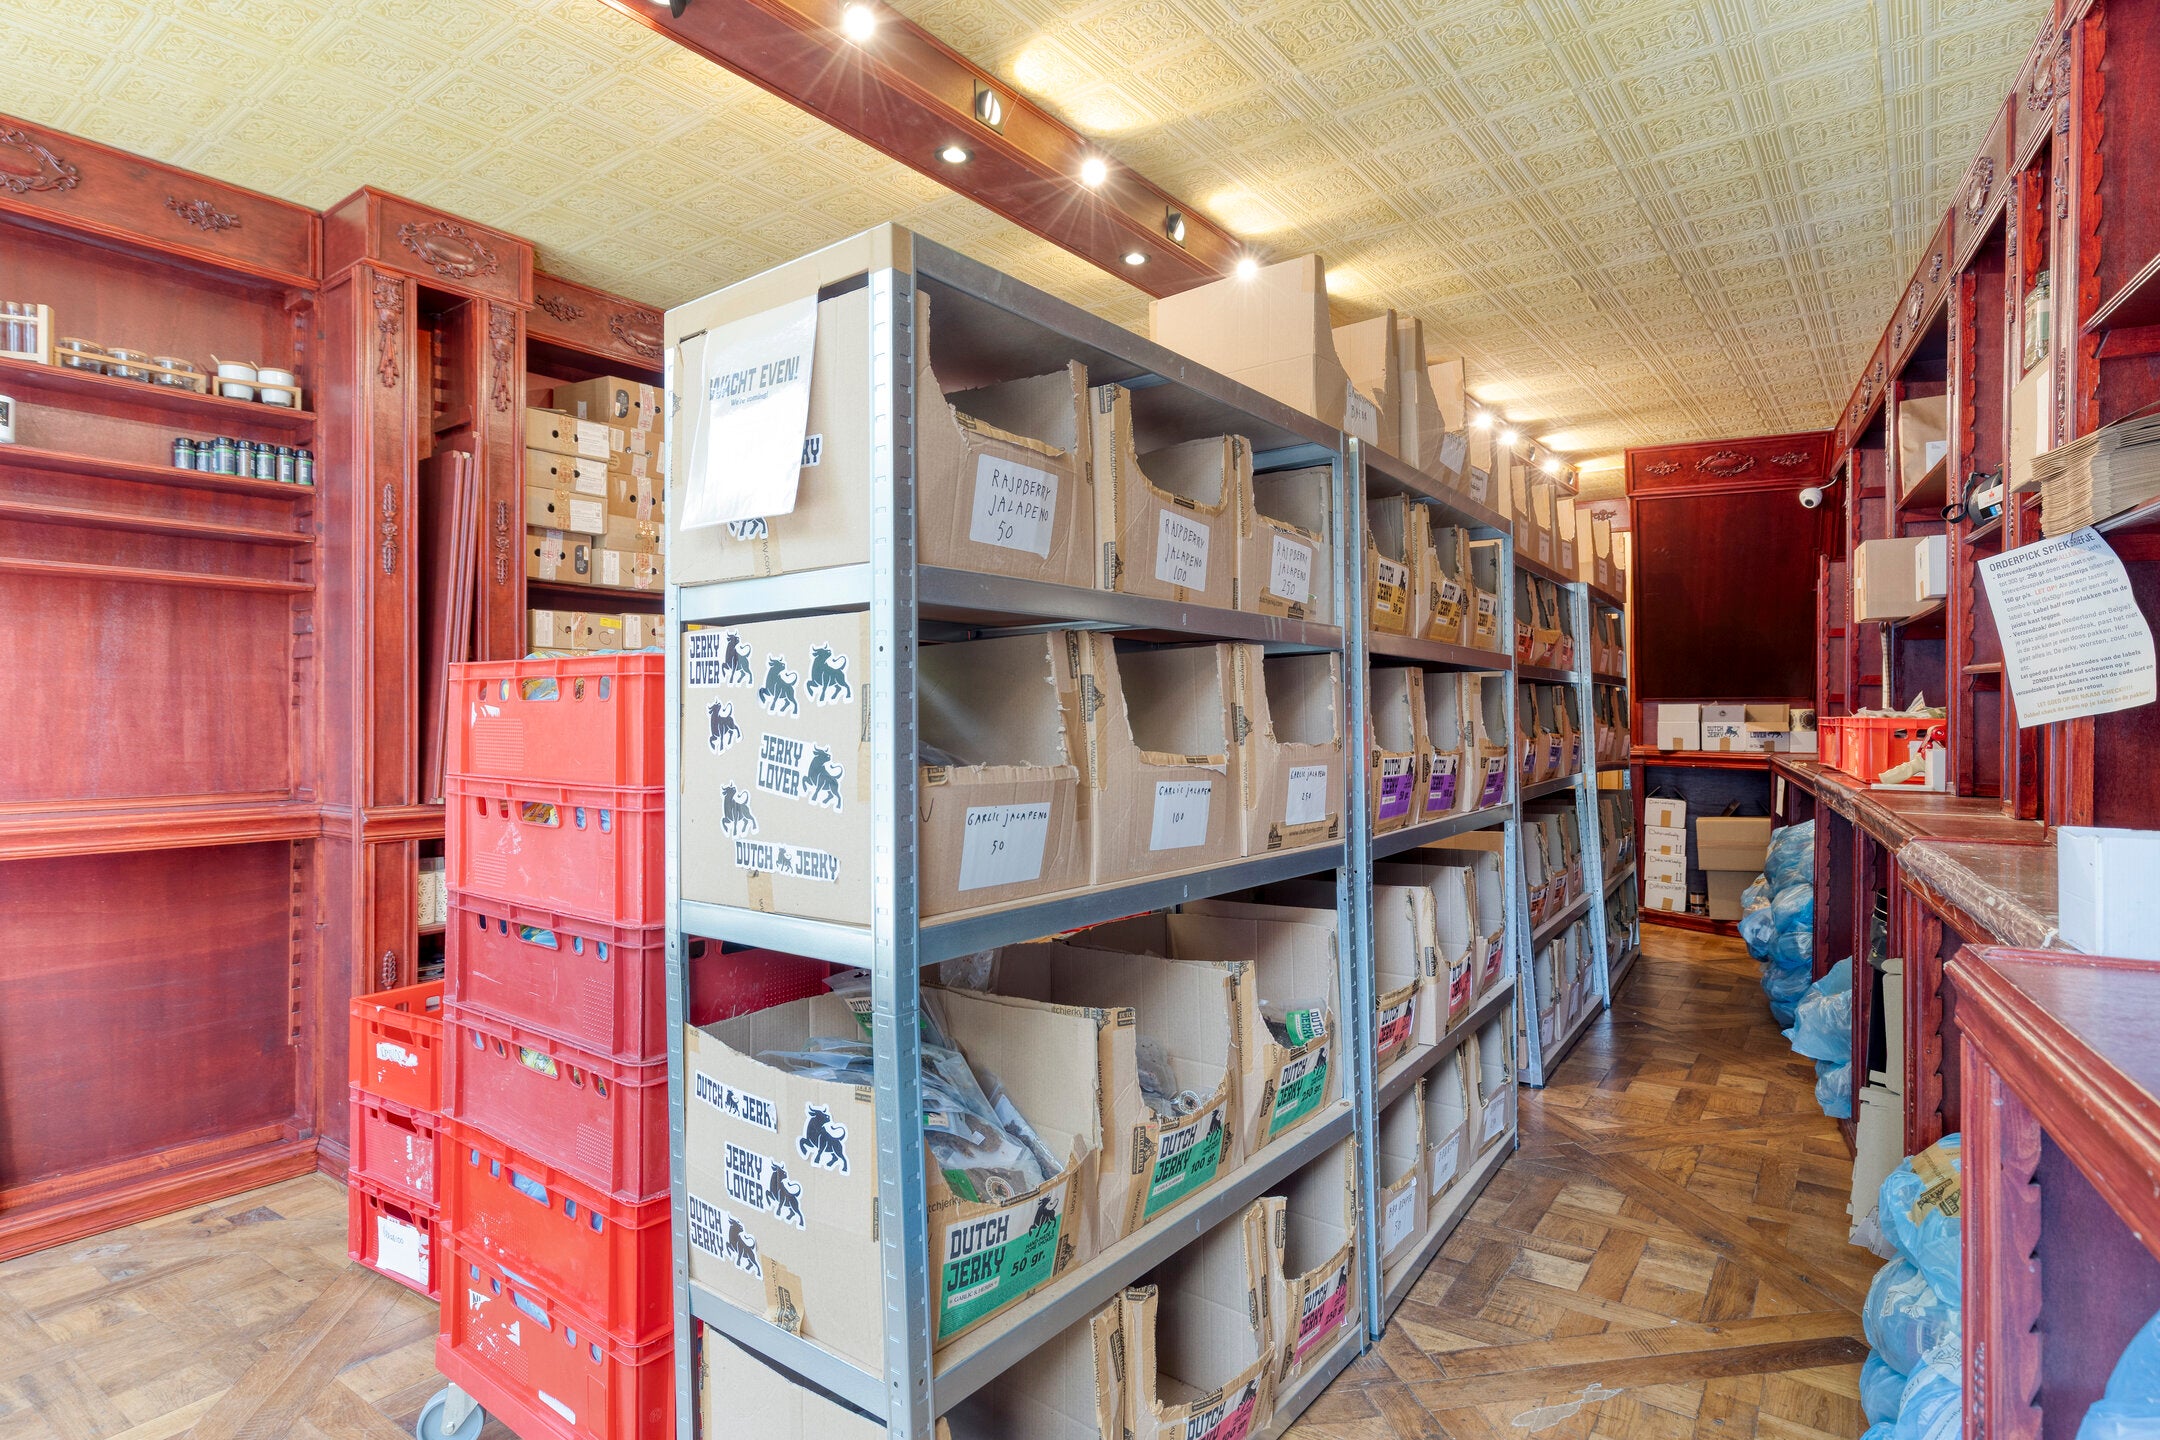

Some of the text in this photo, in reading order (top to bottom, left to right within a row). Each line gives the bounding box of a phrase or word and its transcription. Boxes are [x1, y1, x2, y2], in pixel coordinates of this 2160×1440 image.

[709, 356, 800, 401] WACHT EVEN!
[997, 520, 1014, 541] 50
[1989, 550, 2041, 572] ORDERPICK
[1173, 567, 1187, 582] 100
[1281, 579, 1296, 595] 250
[2033, 604, 2050, 615] Label
[2076, 591, 2102, 604] plakken
[690, 635, 720, 659] JERKY
[2072, 656, 2100, 669] barcodes
[2101, 653, 2112, 662] van
[2121, 648, 2142, 659] labels
[690, 660, 720, 685] LOVER
[2068, 675, 2089, 686] Anders
[2089, 671, 2109, 682] werkt
[2118, 667, 2134, 677] code
[2084, 662, 2114, 675] scheuren
[761, 735, 803, 767] JERKY
[758, 761, 800, 797] LOVER
[1172, 813, 1184, 824] 100
[991, 840, 1005, 855] 50
[735, 841, 838, 881] DUTCH JERKY
[696, 1073, 777, 1129] DUTCH JERK
[1160, 1124, 1198, 1160] DUTCH
[726, 1144, 763, 1181] JERKY
[1154, 1148, 1193, 1183] JERKY
[1191, 1159, 1206, 1175] 100
[726, 1170, 764, 1210] LOVER
[689, 1196, 723, 1234] DUTCH
[690, 1223, 724, 1259] JERKY
[950, 1215, 1009, 1259] DUTCH
[947, 1247, 1006, 1291] JERKY
[1010, 1253, 1046, 1277] 50 gr.
[954, 1292, 975, 1304] GARLIC
[1187, 1401, 1226, 1440] DUTCH
